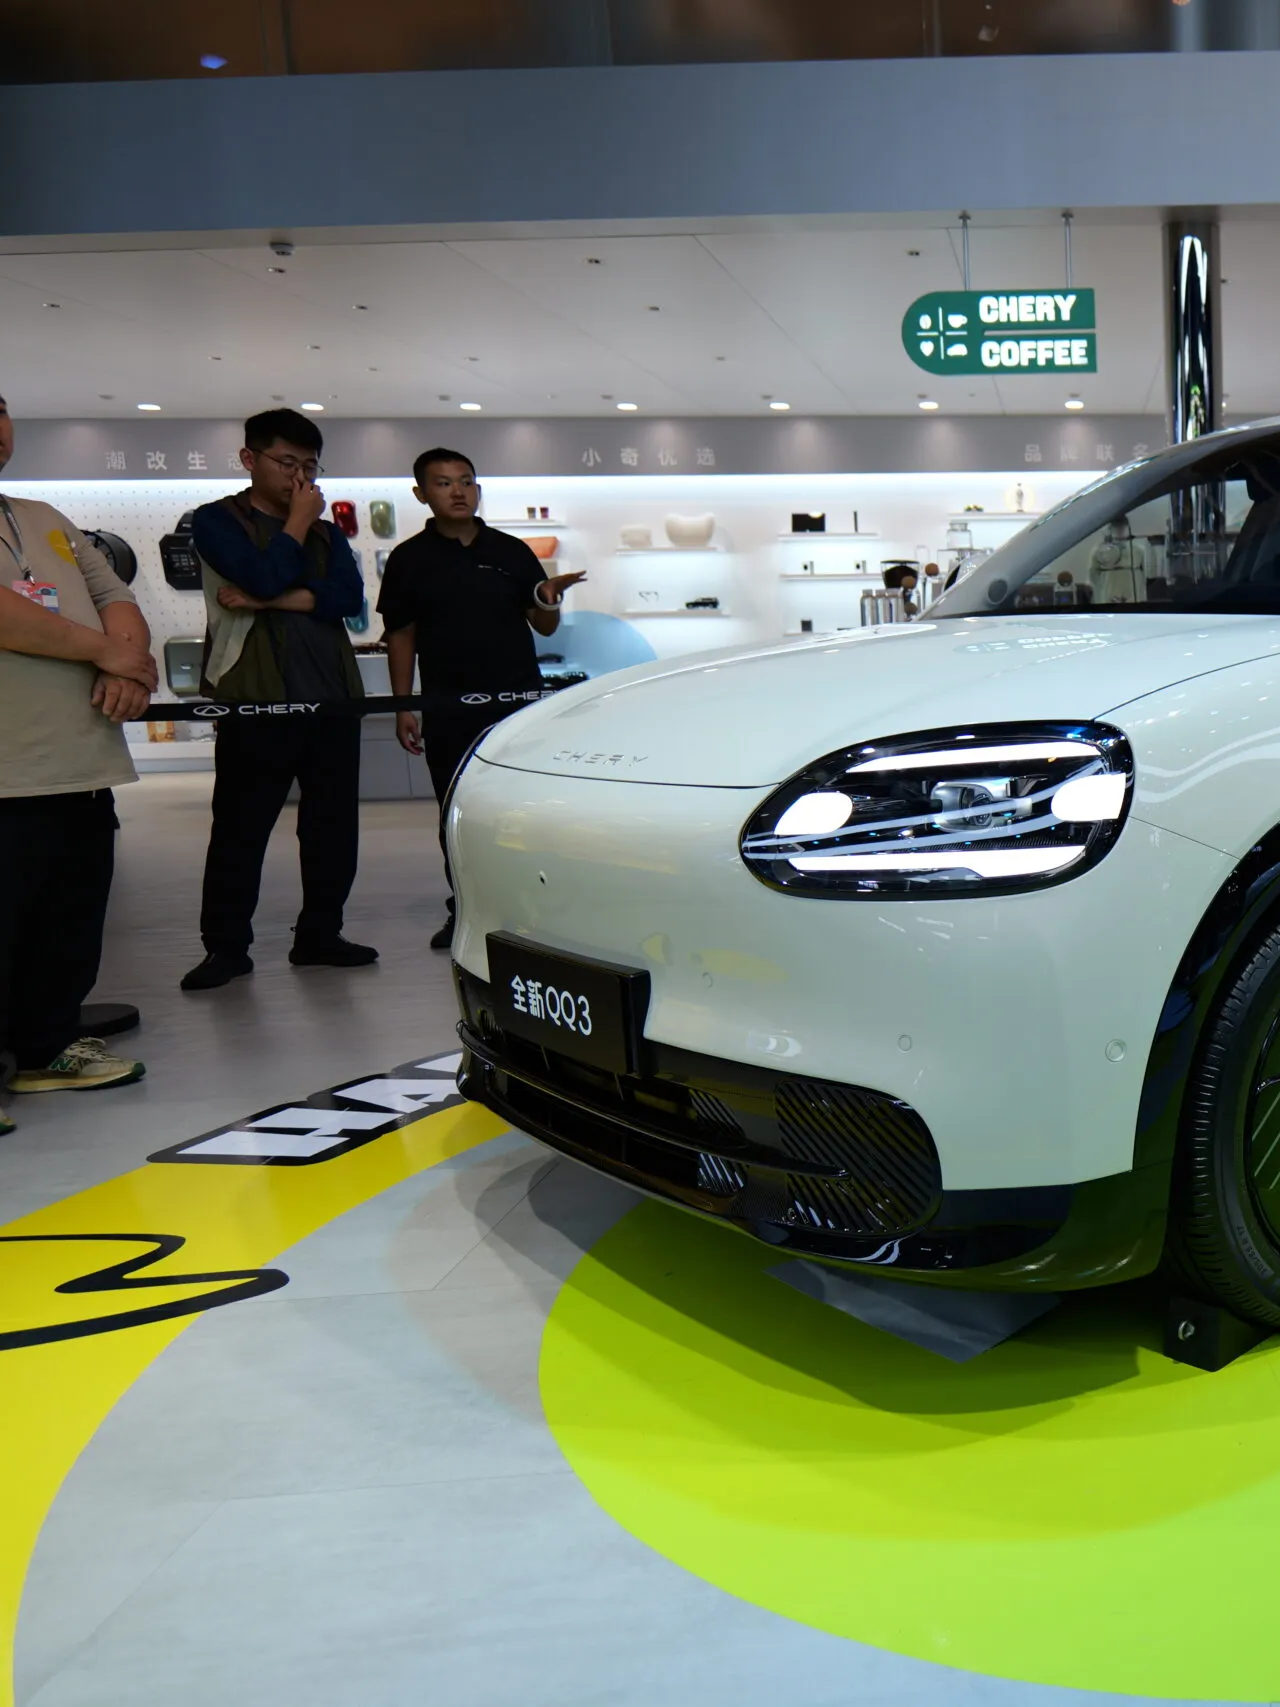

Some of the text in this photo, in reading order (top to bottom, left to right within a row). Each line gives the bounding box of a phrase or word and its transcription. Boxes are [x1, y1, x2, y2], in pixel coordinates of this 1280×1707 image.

[979, 295, 1076, 323] CHERY
[980, 339, 1088, 367] COFFEE
[582, 447, 716, 466] 小奇优选
[498, 690, 556, 701] CHER
[239, 703, 320, 715] CHERY
[553, 750, 648, 767] CHERY
[511, 975, 592, 1036] 全新QQ3
